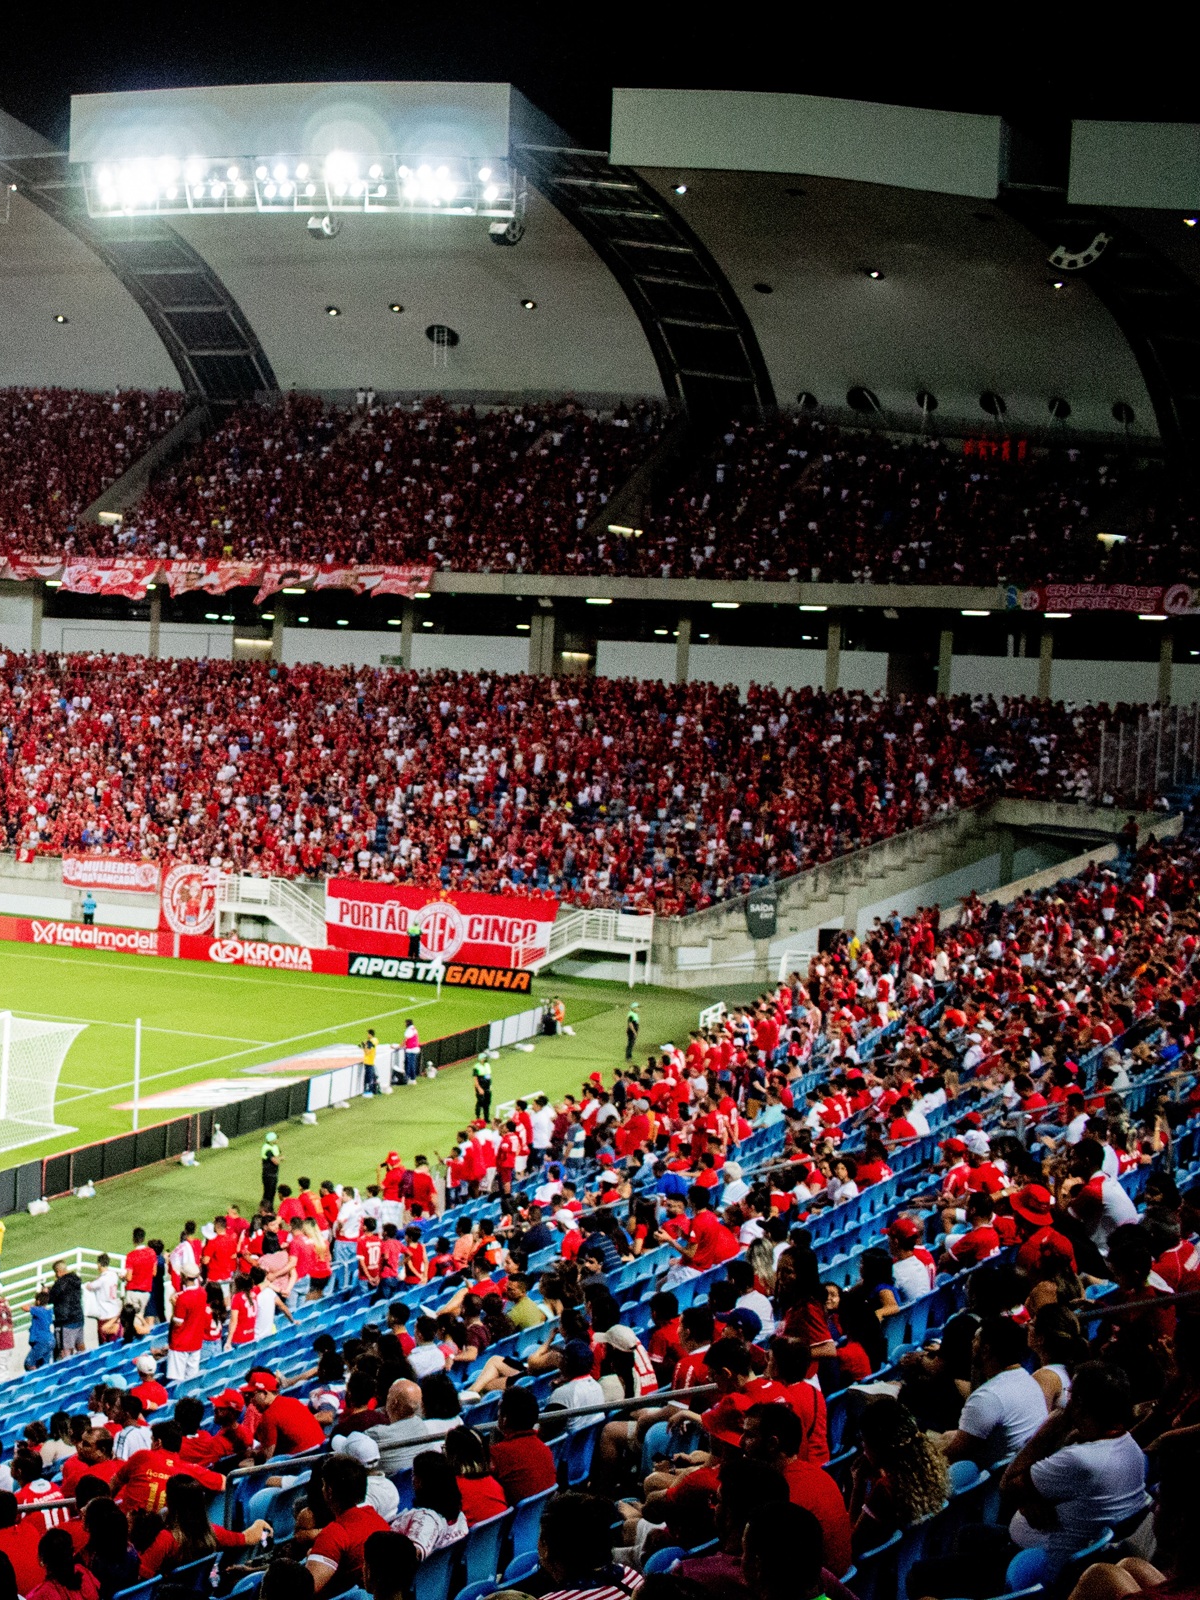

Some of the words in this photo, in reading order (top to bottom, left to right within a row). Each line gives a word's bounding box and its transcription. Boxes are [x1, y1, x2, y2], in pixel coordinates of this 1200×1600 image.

[750, 902, 774, 913] SAÍDA
[338, 899, 408, 932] PORTÃO
[468, 916, 538, 944] CINCO
[243, 943, 313, 965] KRONA
